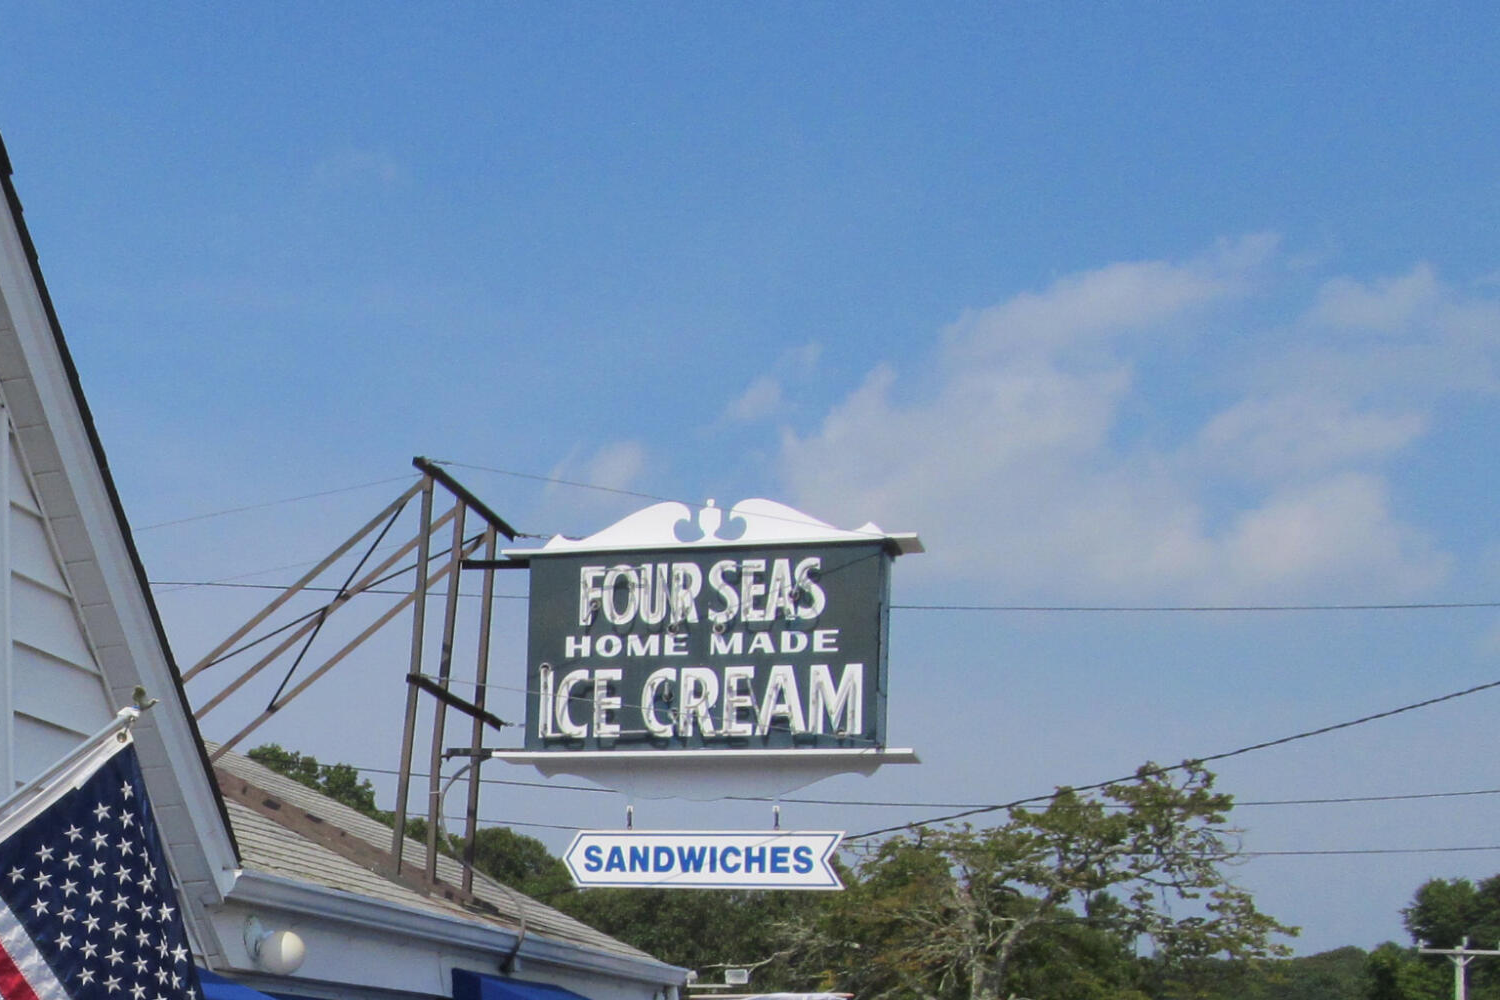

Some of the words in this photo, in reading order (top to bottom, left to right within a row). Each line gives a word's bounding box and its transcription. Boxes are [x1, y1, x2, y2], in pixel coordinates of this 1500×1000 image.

[579, 562, 702, 626] FOUR
[708, 557, 826, 622] SEAS
[565, 633, 689, 657] HOME
[710, 629, 839, 655] MADE
[539, 668, 622, 738] ICE
[642, 663, 863, 738] CREAM
[583, 845, 814, 874] SANDWICHES
